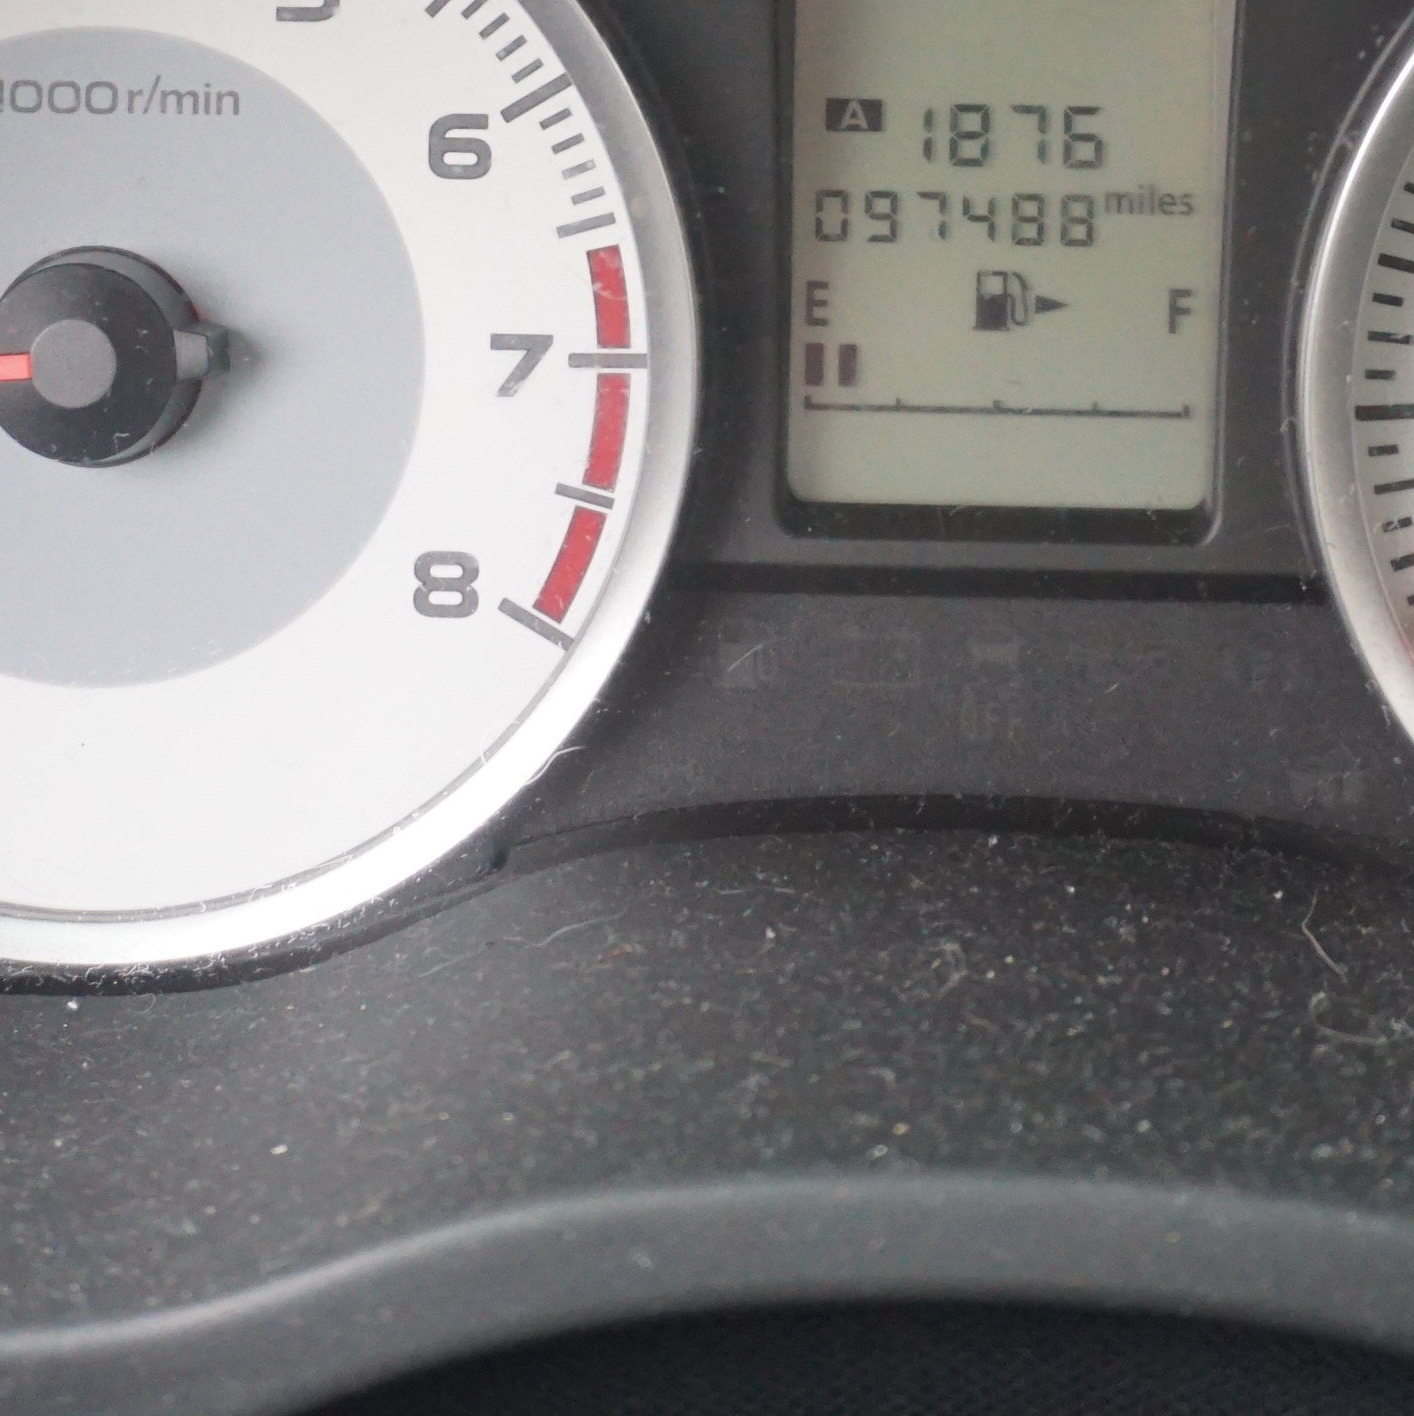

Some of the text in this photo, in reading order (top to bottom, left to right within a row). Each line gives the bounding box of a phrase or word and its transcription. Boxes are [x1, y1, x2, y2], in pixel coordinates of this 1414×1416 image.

[427, 112, 493, 181] 6
[922, 102, 1105, 170] 1876
[814, 184, 1196, 248] 097488 miles
[804, 280, 830, 327] E
[1167, 288, 1194, 335] F
[489, 332, 555, 398] 7
[412, 550, 480, 619] 8
